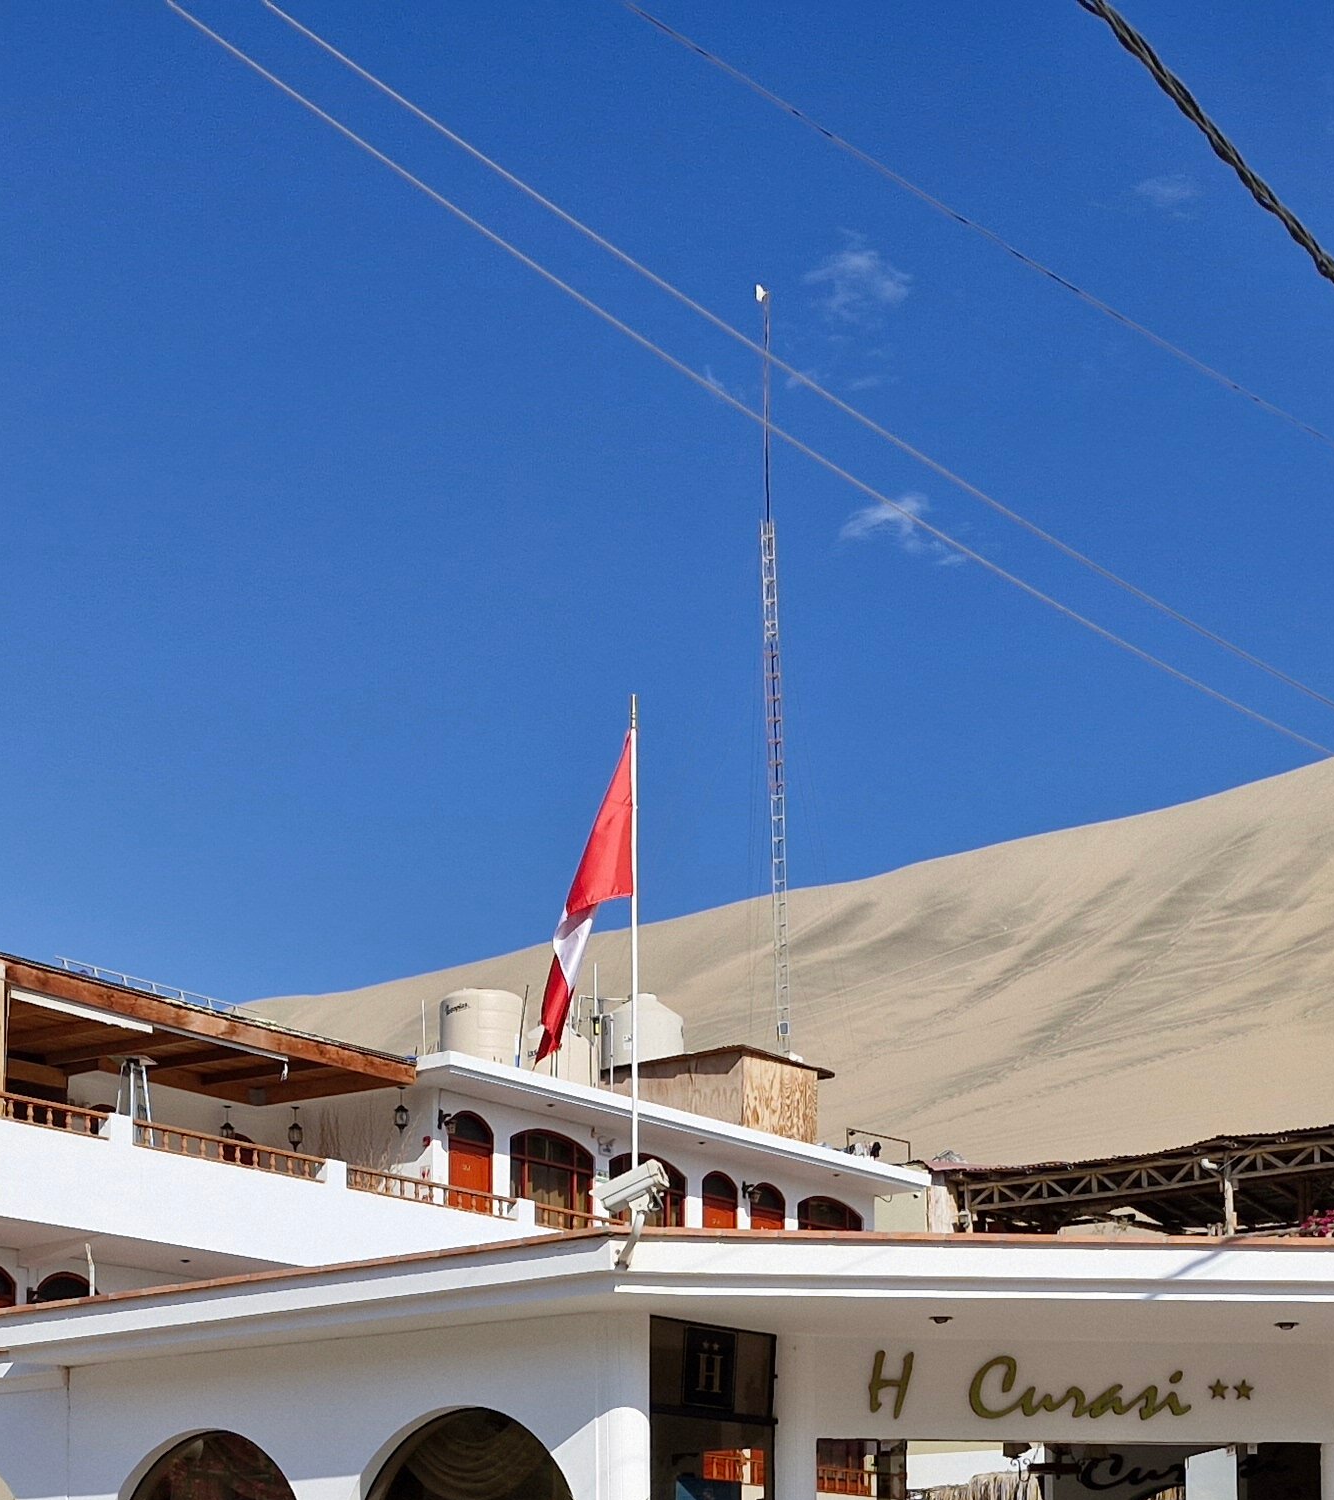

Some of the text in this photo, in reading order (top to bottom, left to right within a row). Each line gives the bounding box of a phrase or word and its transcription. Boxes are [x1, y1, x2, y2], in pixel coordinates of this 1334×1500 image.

[695, 1353, 724, 1393] H
[869, 1350, 1193, 1420] H Curasi
